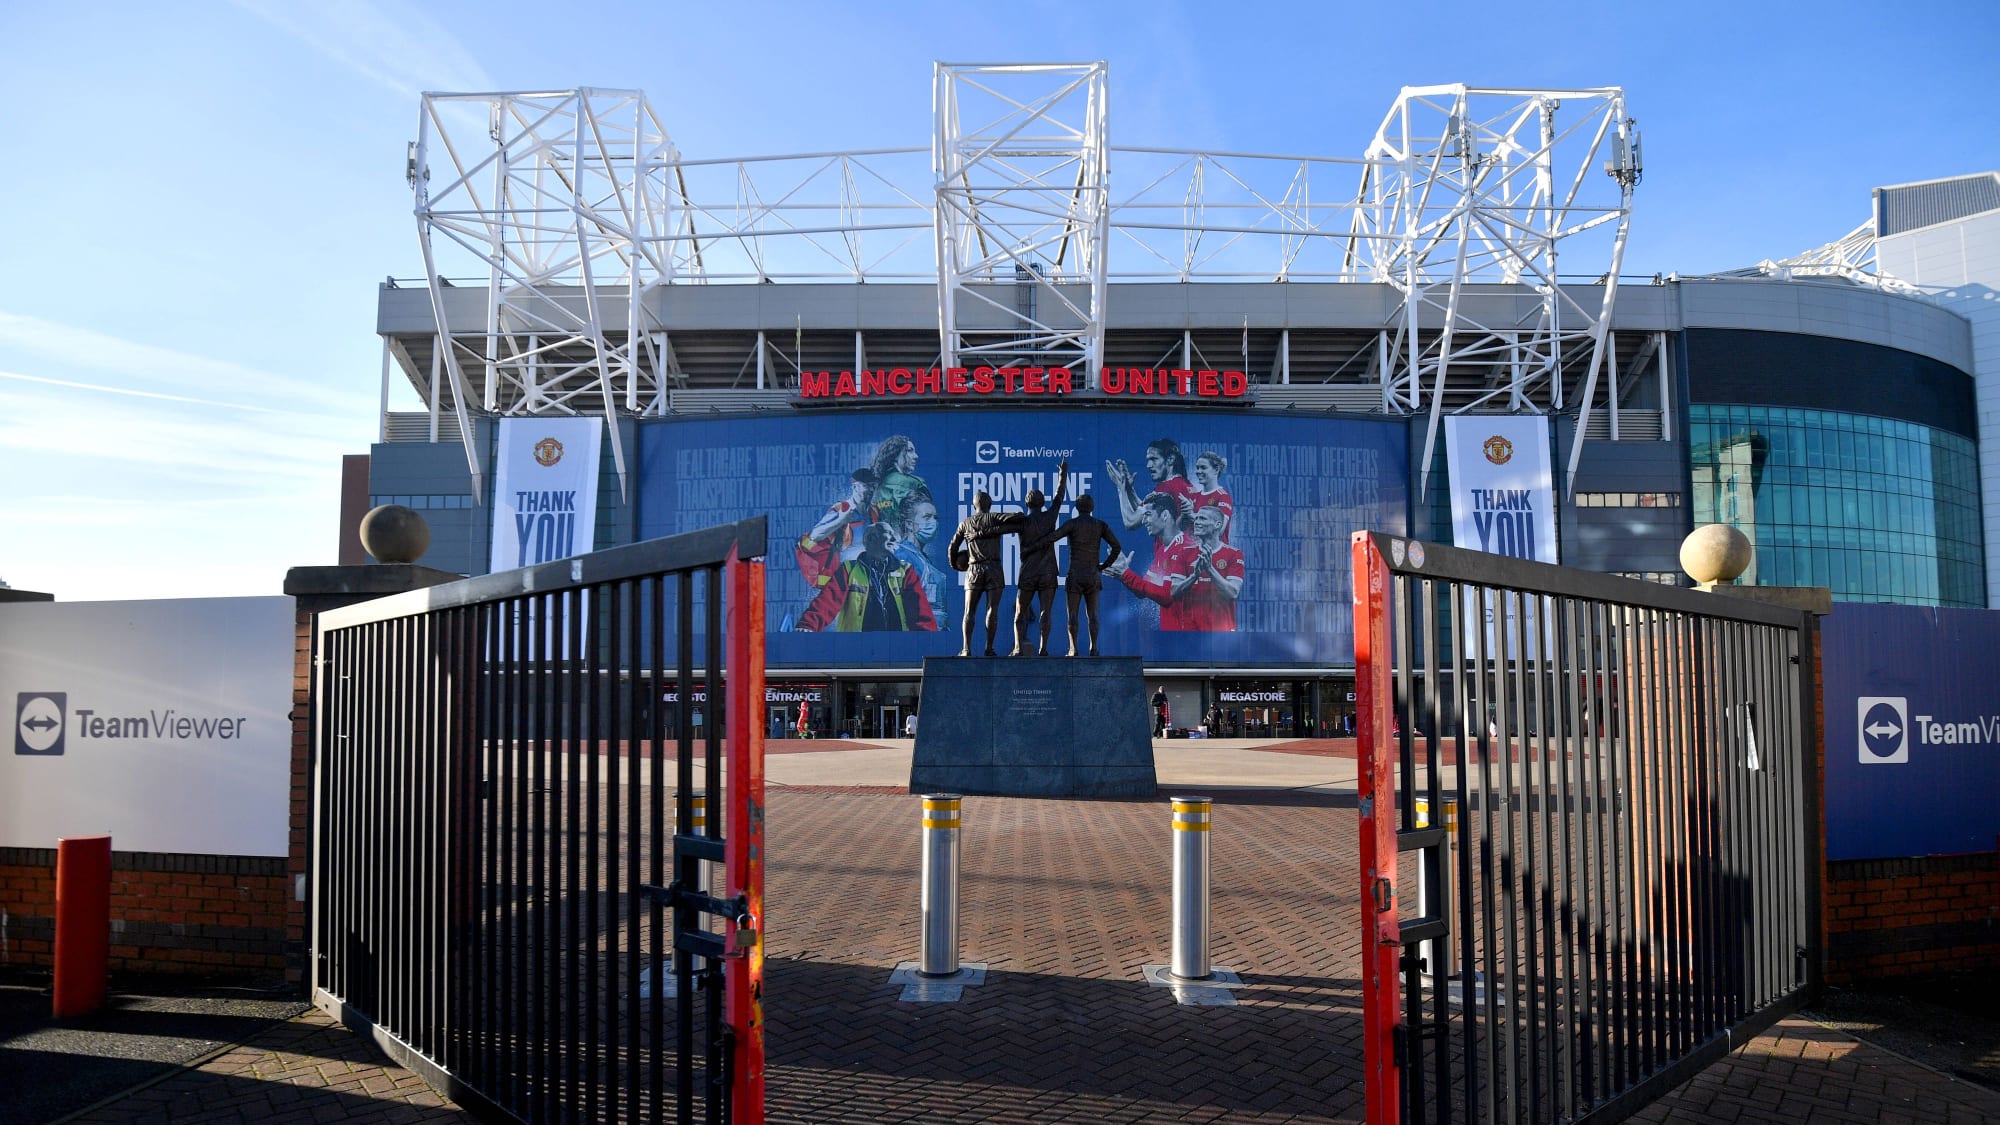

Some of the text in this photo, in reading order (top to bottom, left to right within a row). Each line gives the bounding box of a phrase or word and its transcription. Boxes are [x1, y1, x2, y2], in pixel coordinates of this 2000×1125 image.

[801, 367, 1248, 397] MANCHESTER UNITED
[677, 446, 751, 479] HEALTHCARE
[756, 444, 816, 476] WORKERS
[1003, 446, 1074, 458] TeamViewer
[1246, 444, 1317, 476] PROBATION
[1322, 447, 1379, 478] OFFICERS
[516, 490, 577, 512] THANK
[676, 477, 782, 510] TRANSPORTATION
[958, 472, 1093, 502] FRONTLINE
[1227, 474, 1379, 509] SOCIAL CARE WORKERS
[1471, 489, 1532, 511] THANK
[515, 512, 575, 567] YOU
[1473, 511, 1536, 560] YOU
[1220, 692, 1286, 701] MEGASTORE
[76, 710, 247, 739] TeamViewer
